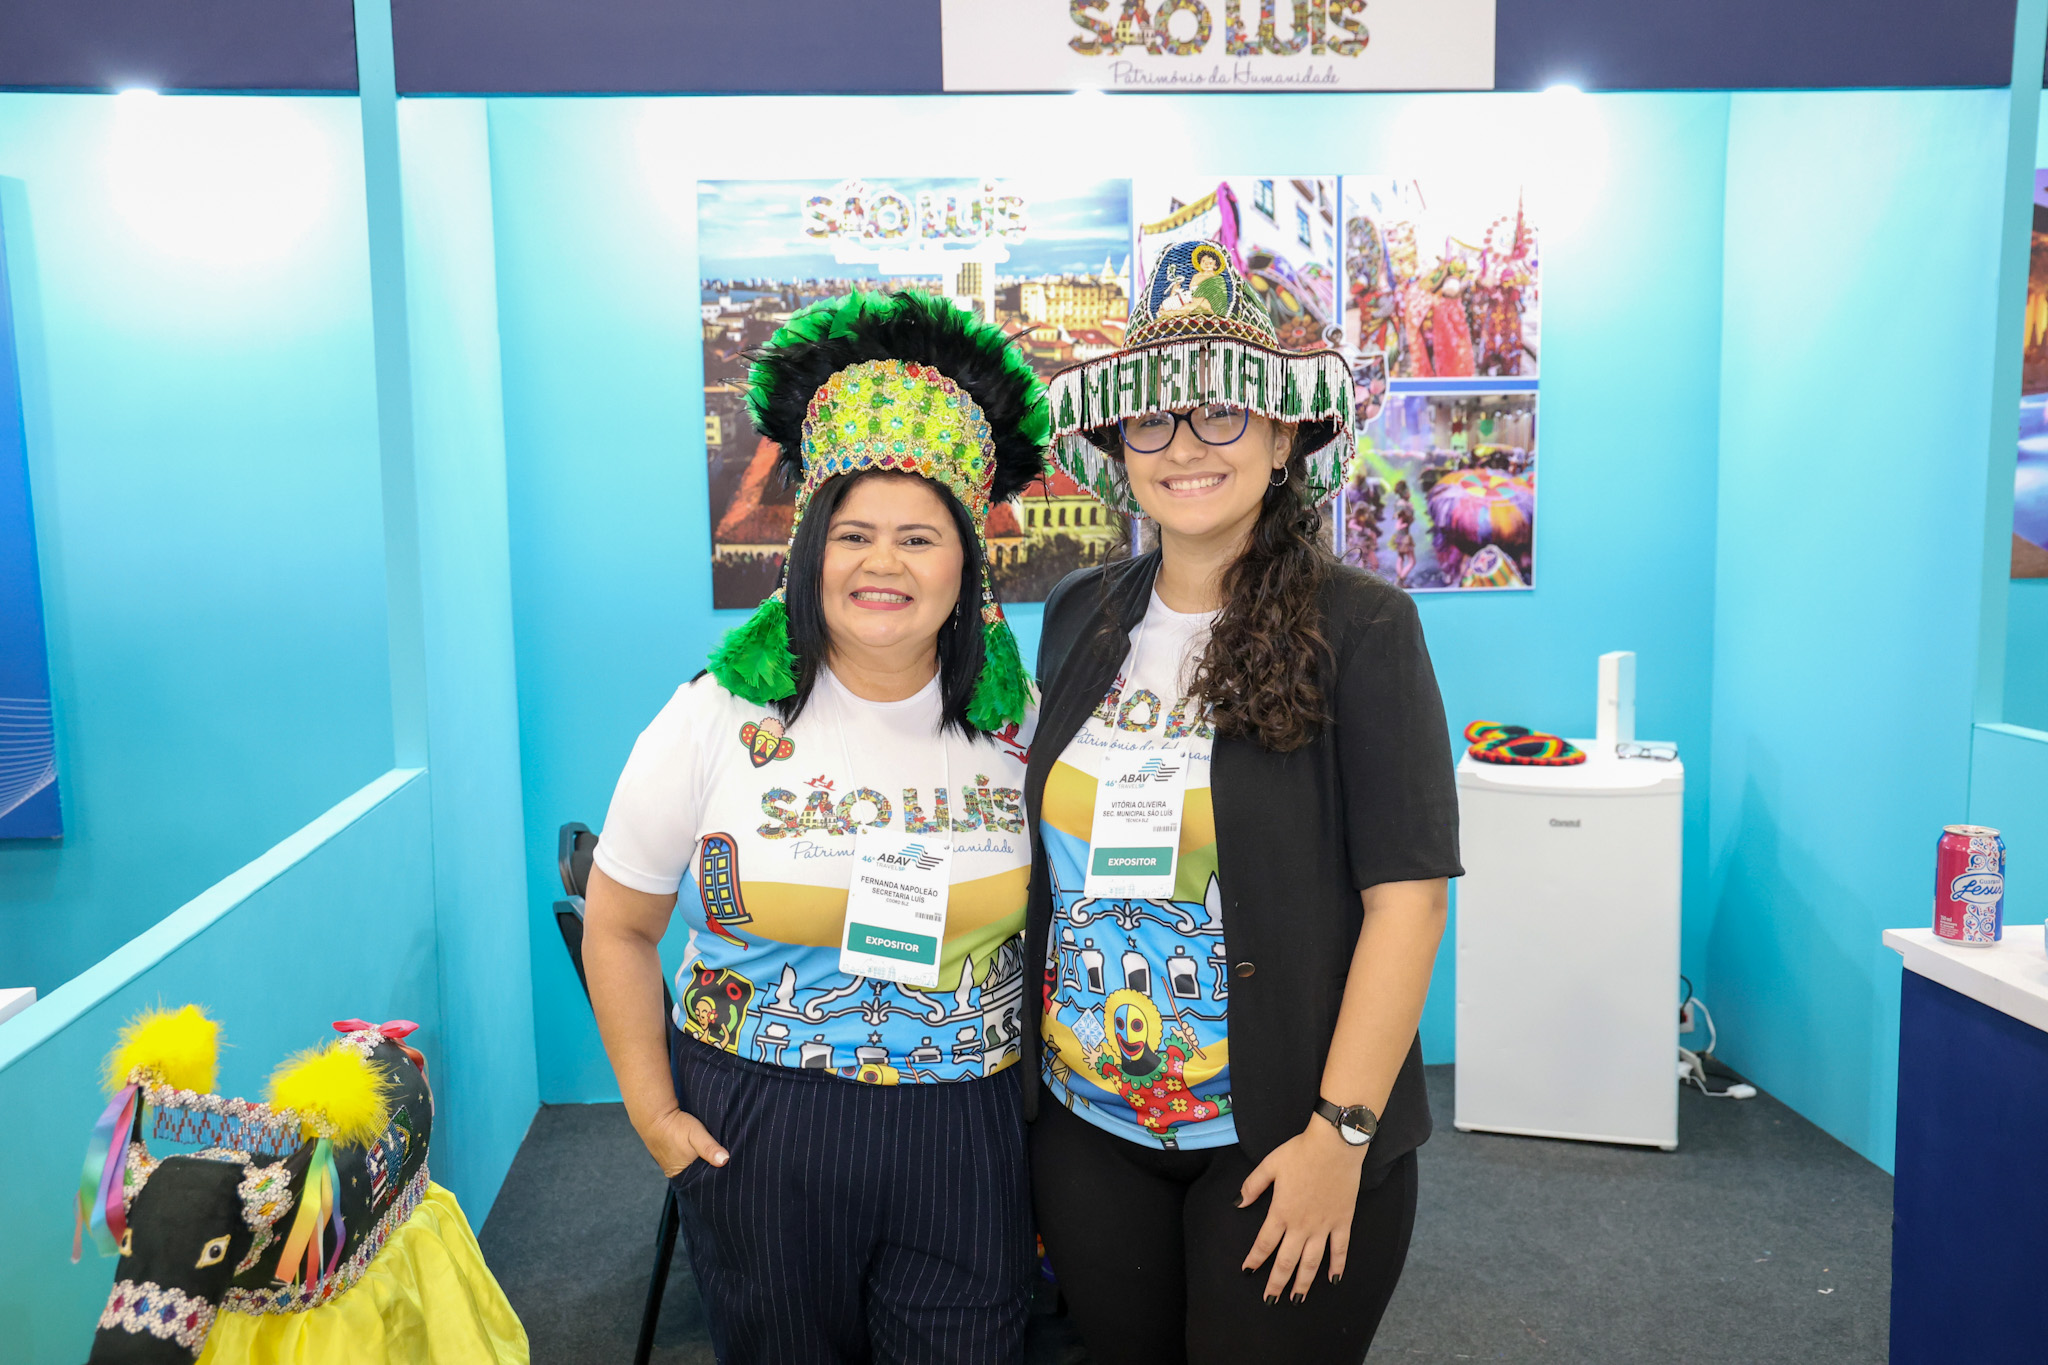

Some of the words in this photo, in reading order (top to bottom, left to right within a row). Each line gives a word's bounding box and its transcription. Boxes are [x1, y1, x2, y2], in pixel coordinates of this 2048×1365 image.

[1108, 60, 1206, 86] Patrimônio
[1208, 66, 1230, 85] da
[1232, 61, 1340, 86] Humanidade
[1119, 773, 1150, 784] ABAV
[756, 774, 893, 840] SÃO
[903, 773, 1025, 834] LUÍS
[1111, 800, 1137, 809] VITÓRIA
[1137, 801, 1167, 809] OLIVEIRA
[1116, 810, 1146, 818] MUNICIPAL
[1147, 809, 1159, 818] SÃO
[789, 840, 855, 860] Patrim
[877, 852, 911, 867] ABAV
[1107, 857, 1157, 867] EXPOSITOR
[860, 875, 899, 890] FERNANDA
[899, 883, 938, 898] NAPOLEÃO
[871, 887, 910, 901] SECRETARIA
[910, 893, 925, 904] LUÍS
[865, 935, 920, 953] EXPOSITOR
